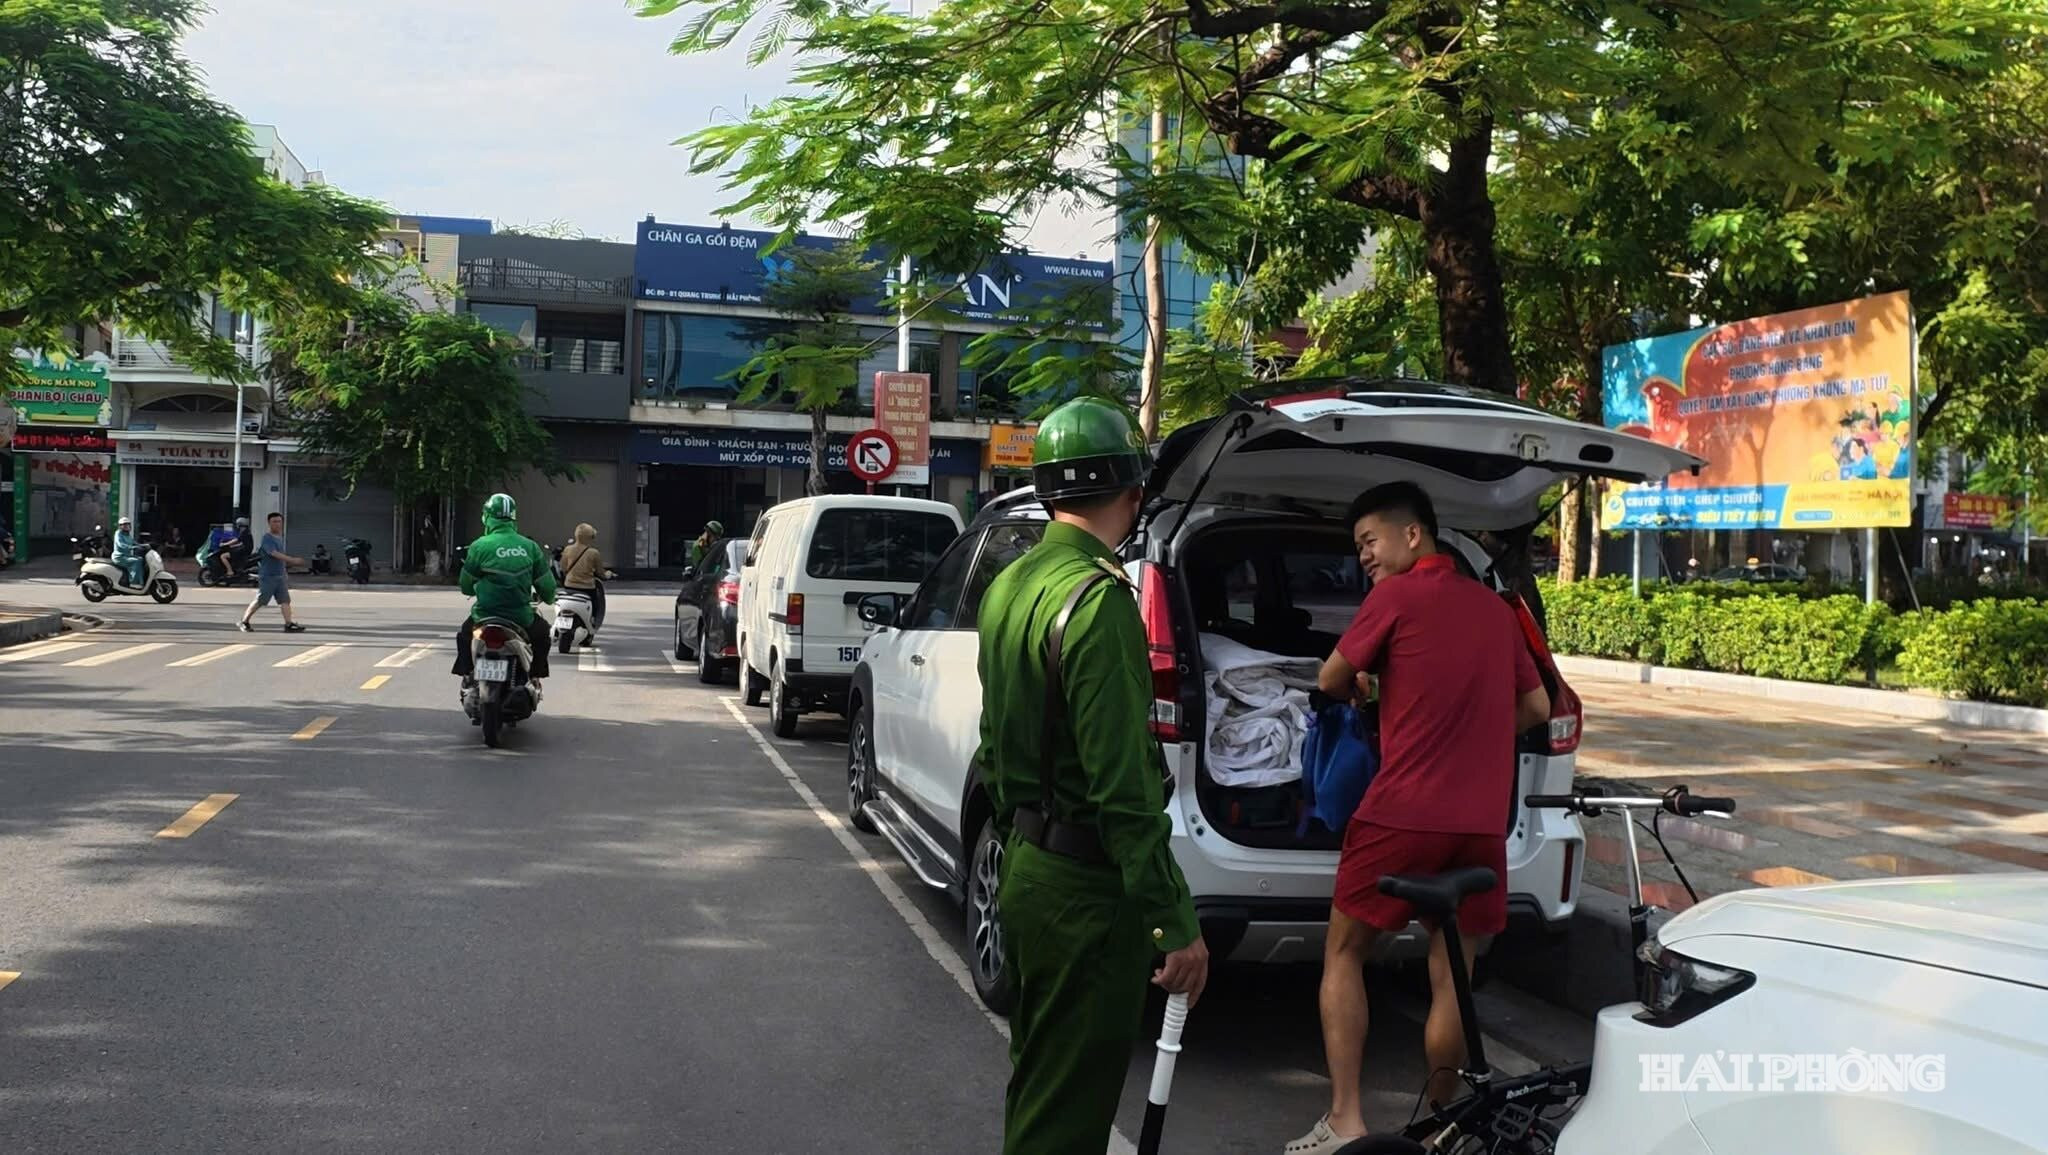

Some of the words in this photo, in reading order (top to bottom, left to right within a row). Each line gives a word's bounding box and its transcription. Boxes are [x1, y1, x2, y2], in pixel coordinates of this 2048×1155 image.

[648, 230, 681, 243] CHĂN
[686, 233, 702, 245] GA
[706, 231, 727, 247] GỐI
[730, 236, 757, 251] ĐỆM
[1043, 265, 1105, 279] WWW.ELAN.VN
[10, 391, 42, 402] PHAN
[45, 391, 66, 403] BỘI
[662, 437, 681, 446] GIA
[684, 435, 709, 447] ĐÌNH
[718, 437, 755, 449] KHÁCH
[757, 440, 778, 453] SẠN
[785, 440, 812, 452] TRƯỜ
[935, 447, 951, 458] ÁN
[720, 452, 739, 462] MÚT
[743, 451, 764, 463] XỐP
[767, 454, 784, 464] (PU
[496, 546, 528, 558] Grab
